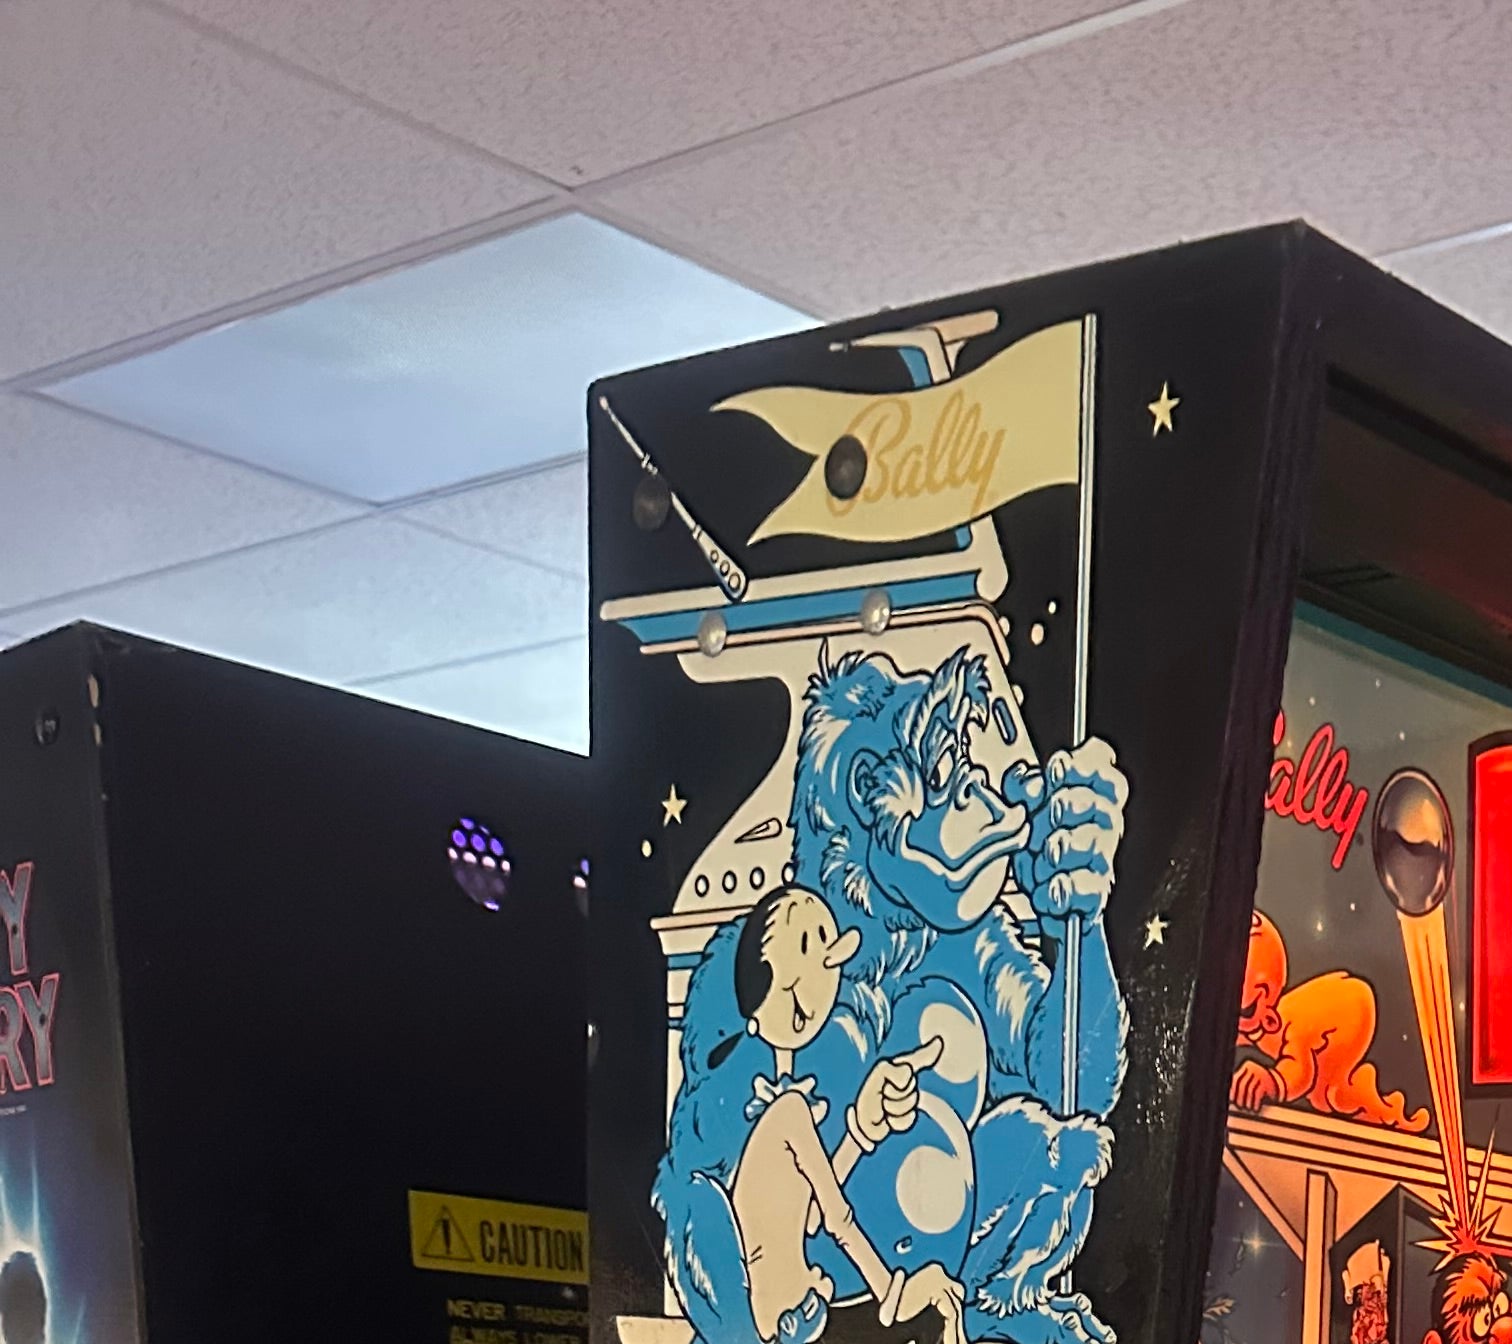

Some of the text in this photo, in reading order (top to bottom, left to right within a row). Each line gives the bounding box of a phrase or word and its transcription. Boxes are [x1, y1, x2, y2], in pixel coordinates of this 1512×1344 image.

[825, 390, 1007, 518] Bally
[1265, 710, 1369, 870] ally
[480, 1220, 584, 1273] CAUTION
[446, 1299, 506, 1320] NEVER
